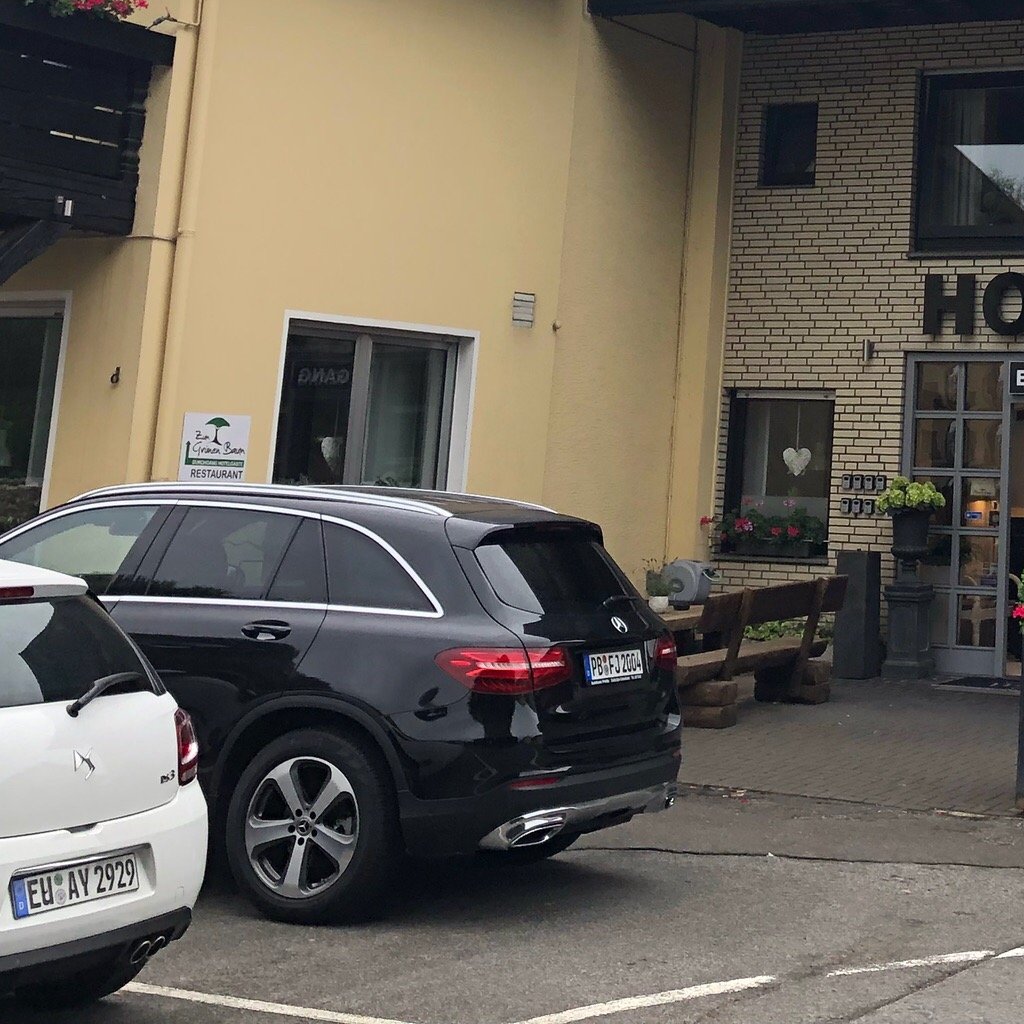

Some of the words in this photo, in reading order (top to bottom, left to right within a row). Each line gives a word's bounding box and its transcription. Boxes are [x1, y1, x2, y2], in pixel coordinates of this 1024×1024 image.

[190, 468, 243, 479] RESTAURANT
[590, 656, 603, 677] PB
[608, 654, 621, 675] FJ
[621, 651, 642, 673] 2004
[26, 876, 55, 909] EU
[68, 867, 91, 900] AY
[94, 858, 136, 894] 2929
